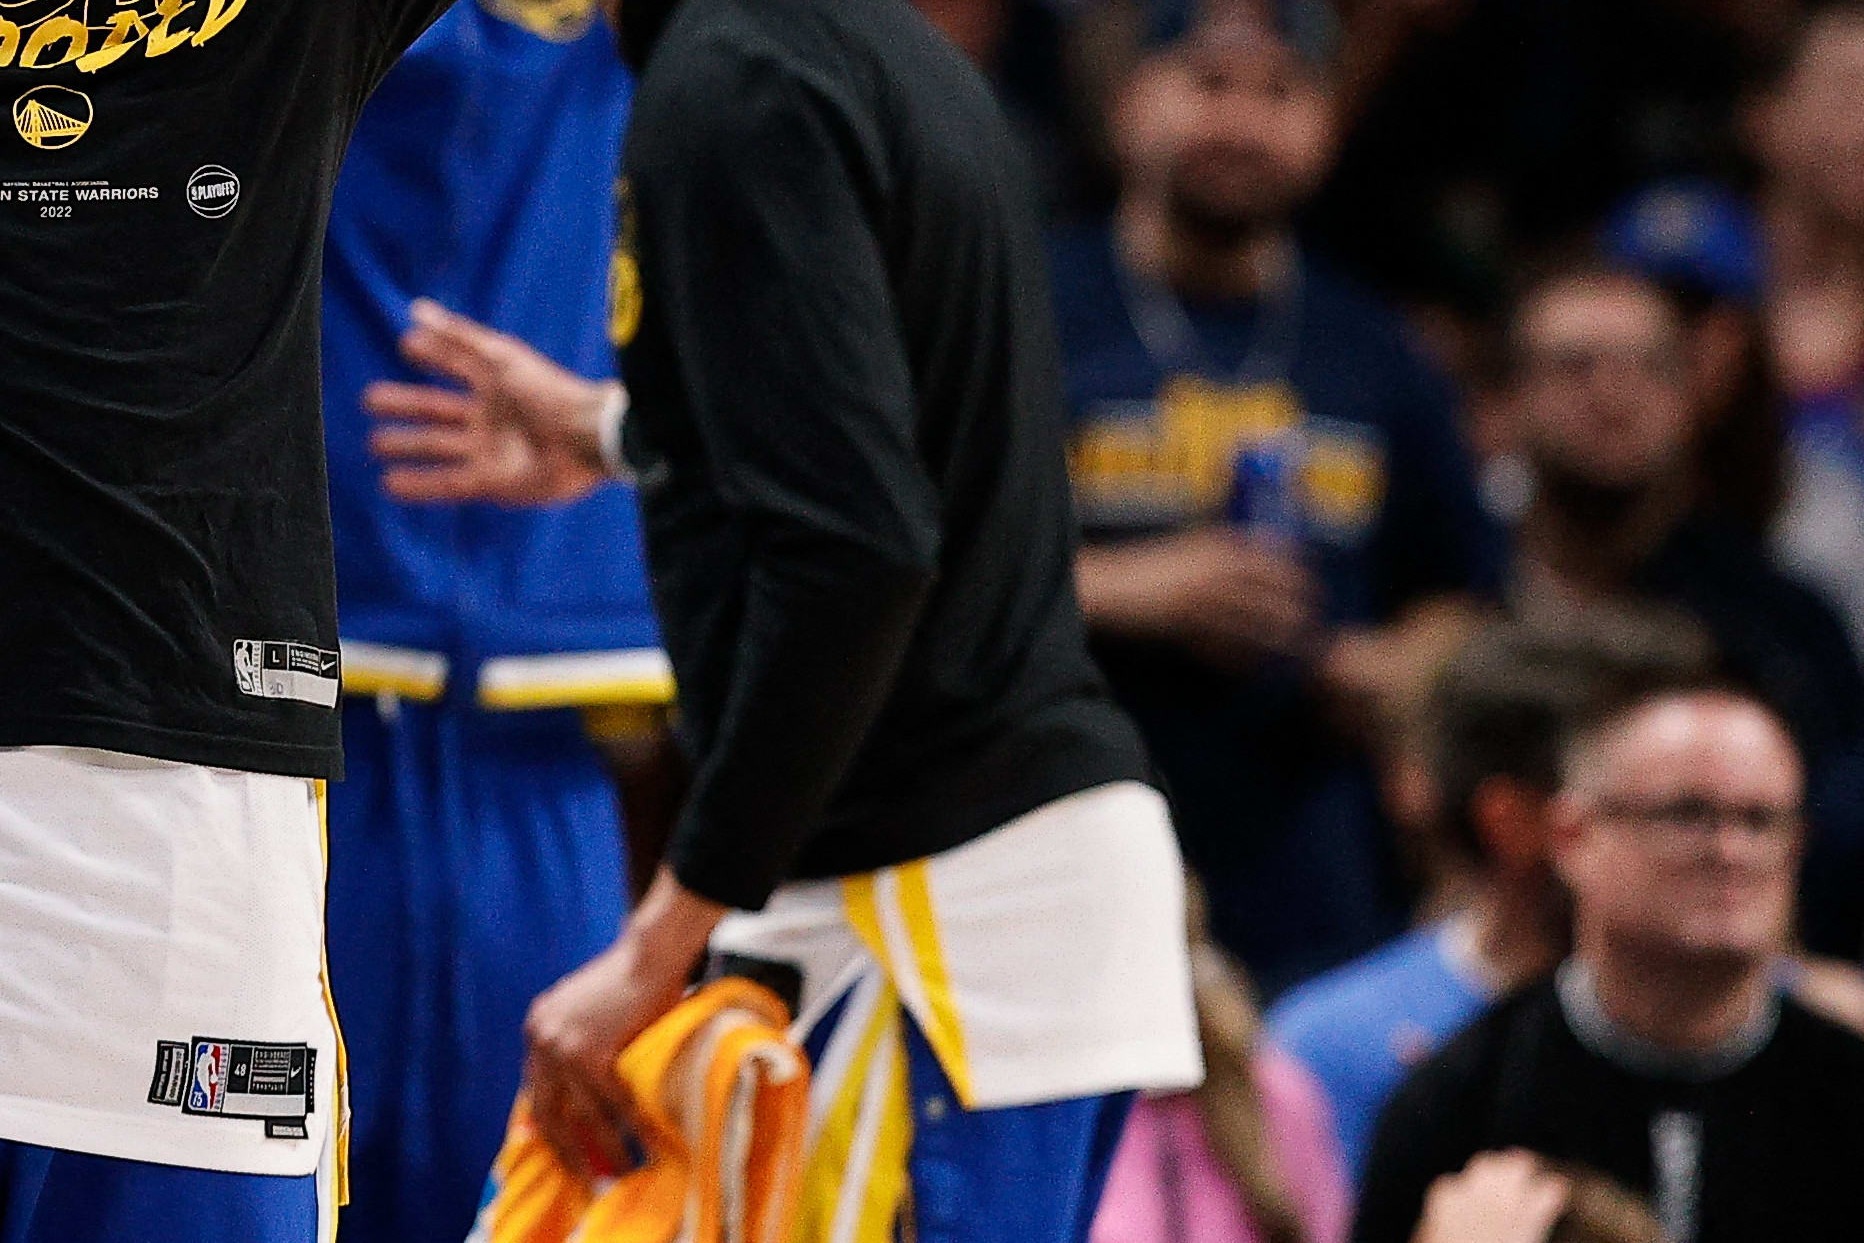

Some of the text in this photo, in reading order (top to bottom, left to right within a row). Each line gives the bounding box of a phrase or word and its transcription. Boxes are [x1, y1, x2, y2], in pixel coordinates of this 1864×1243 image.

[17, 189, 69, 202] STATE
[75, 186, 159, 201] WARRIORS
[198, 180, 235, 200] PLAYOFFS
[40, 205, 72, 218] 2022
[272, 650, 280, 663] L
[234, 1063, 247, 1077] 48
